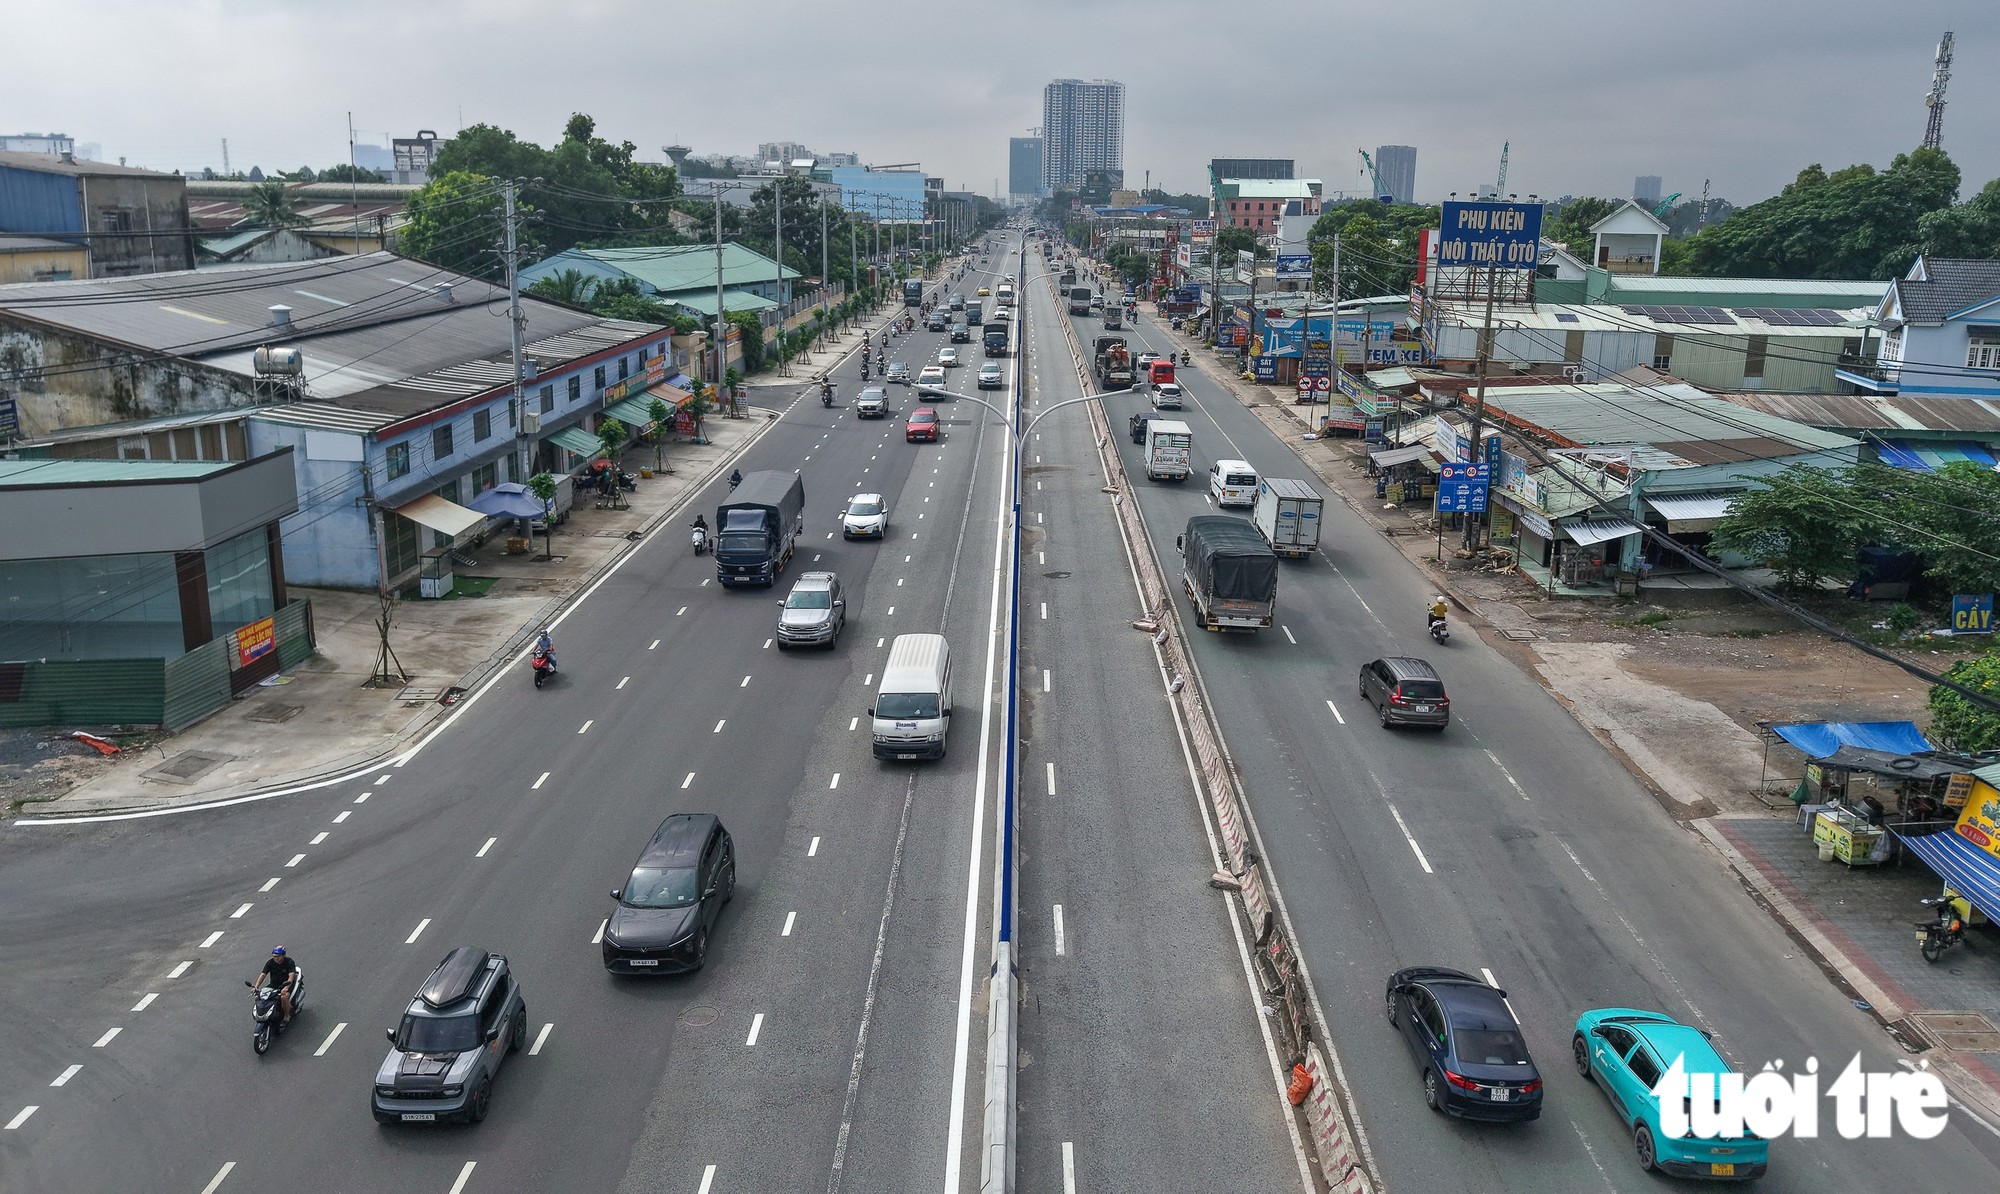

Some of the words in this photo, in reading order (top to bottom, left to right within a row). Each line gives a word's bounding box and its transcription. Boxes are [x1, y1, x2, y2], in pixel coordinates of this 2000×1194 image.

[1458, 209, 1488, 234] PHỤ
[1490, 207, 1525, 235] KIỆN
[1441, 237, 1467, 264] NỘI
[1470, 236, 1505, 262] THẤT
[1507, 239, 1535, 263] ÔTÔ
[1368, 350, 1395, 361] TEM
[1258, 366, 1274, 374] THÉP
